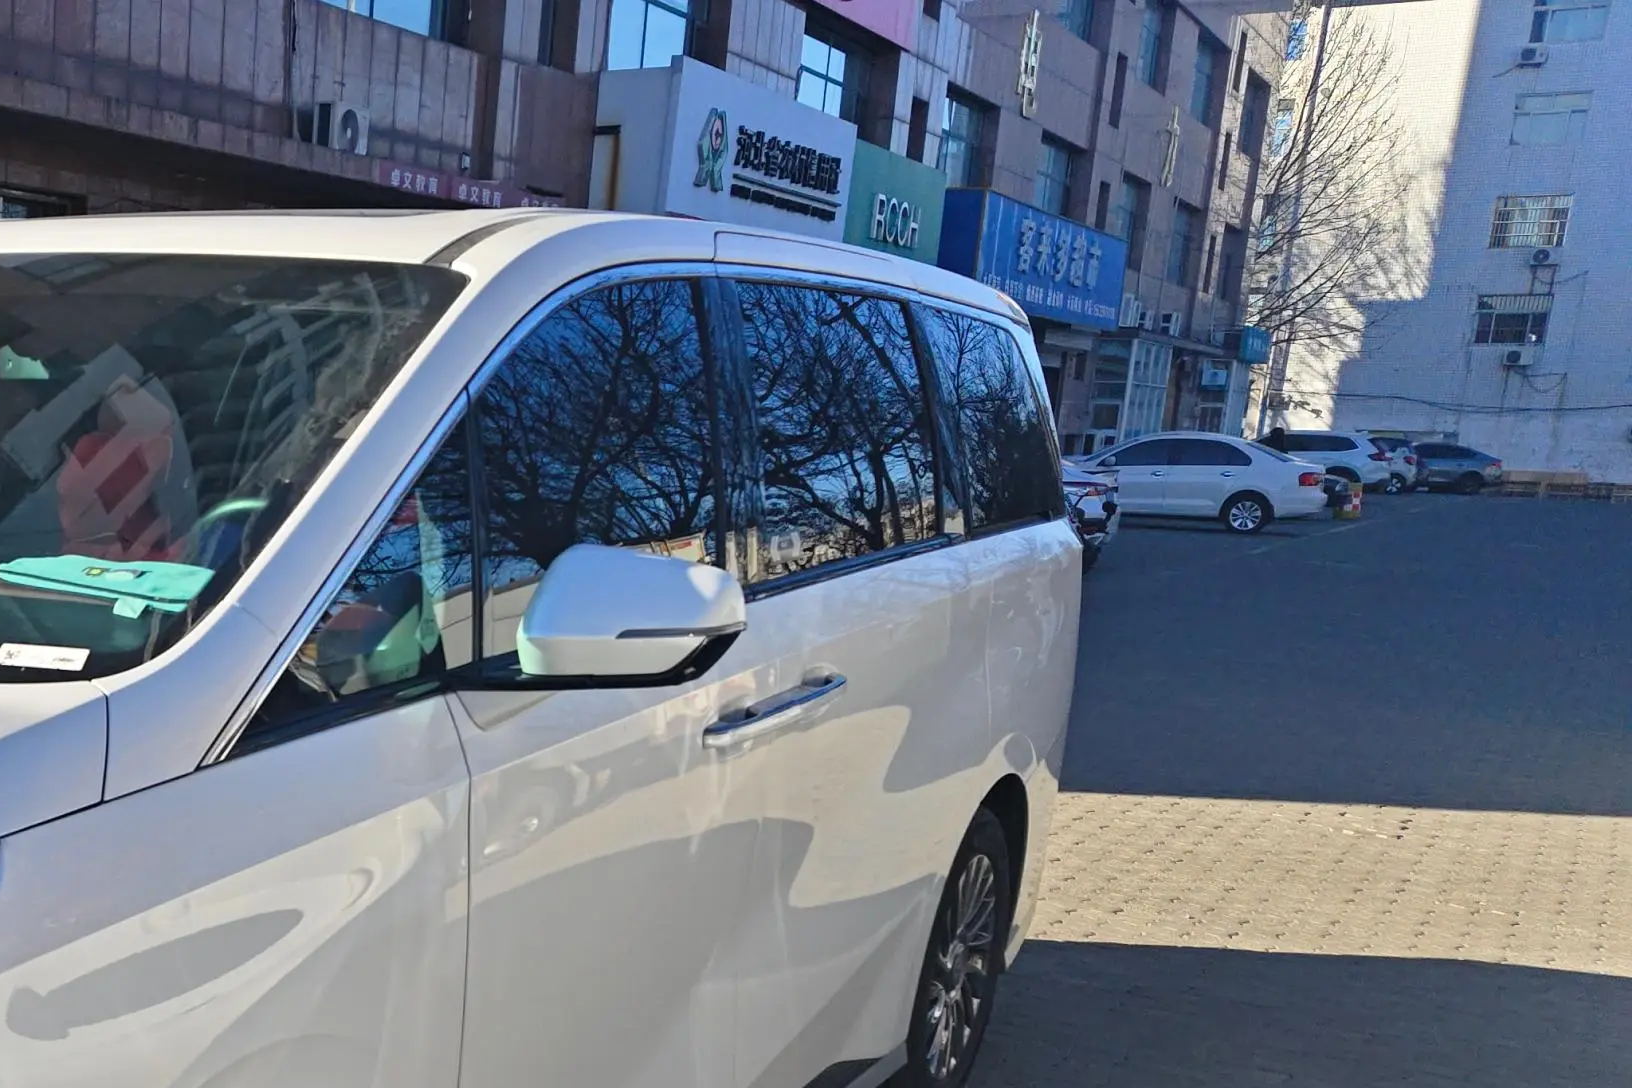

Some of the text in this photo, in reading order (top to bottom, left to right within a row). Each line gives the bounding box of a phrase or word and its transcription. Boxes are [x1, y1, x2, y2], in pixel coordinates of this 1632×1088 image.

[390, 168, 438, 196] 卓文教育
[733, 125, 842, 195] 河北省农村信用社
[457, 183, 502, 208] 卓文教育
[870, 193, 922, 248] RCCH
[1017, 217, 1103, 292] 客来多超市
